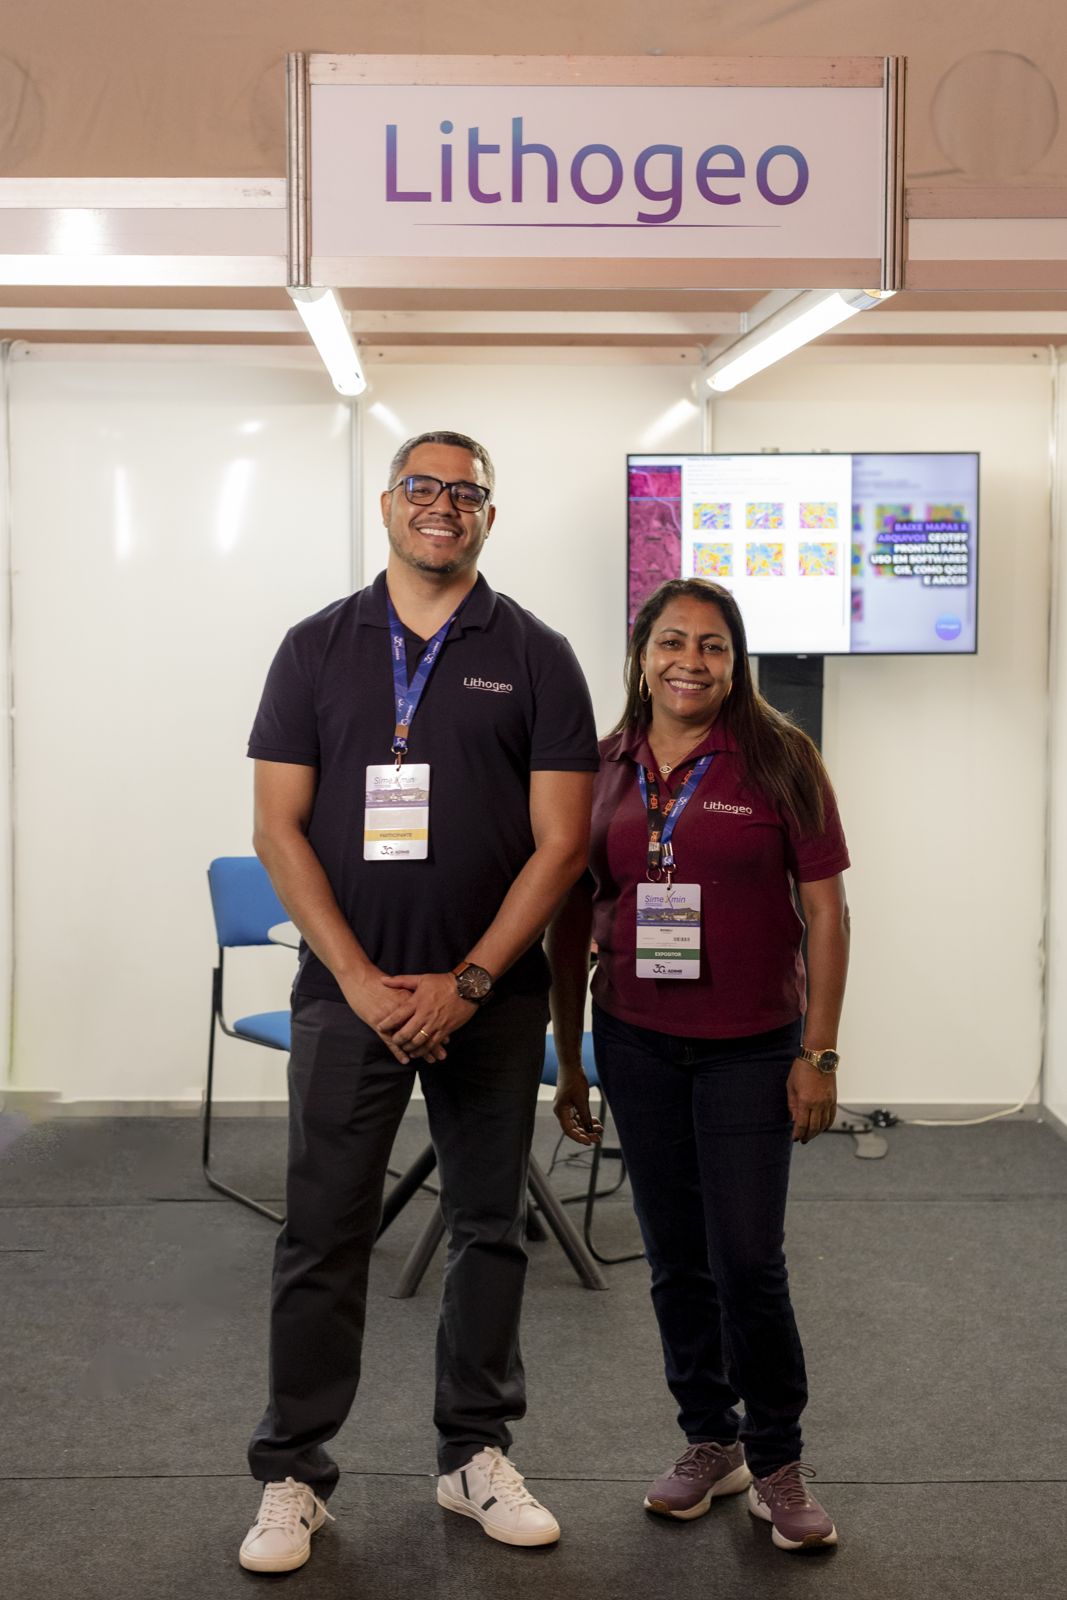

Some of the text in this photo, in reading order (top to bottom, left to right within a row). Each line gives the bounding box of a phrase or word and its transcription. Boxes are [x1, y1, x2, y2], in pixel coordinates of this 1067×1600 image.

[385, 116, 809, 224] Lithogeo
[925, 523, 958, 531] MAPAS
[960, 523, 967, 531] E
[894, 544, 968, 553] PRONTOS PARA
[871, 555, 968, 564] USO EM SOFTWARES
[913, 566, 943, 575] COMO
[924, 576, 931, 585] E
[463, 677, 513, 692] Lithogeo
[703, 801, 753, 815] Lithogeo
